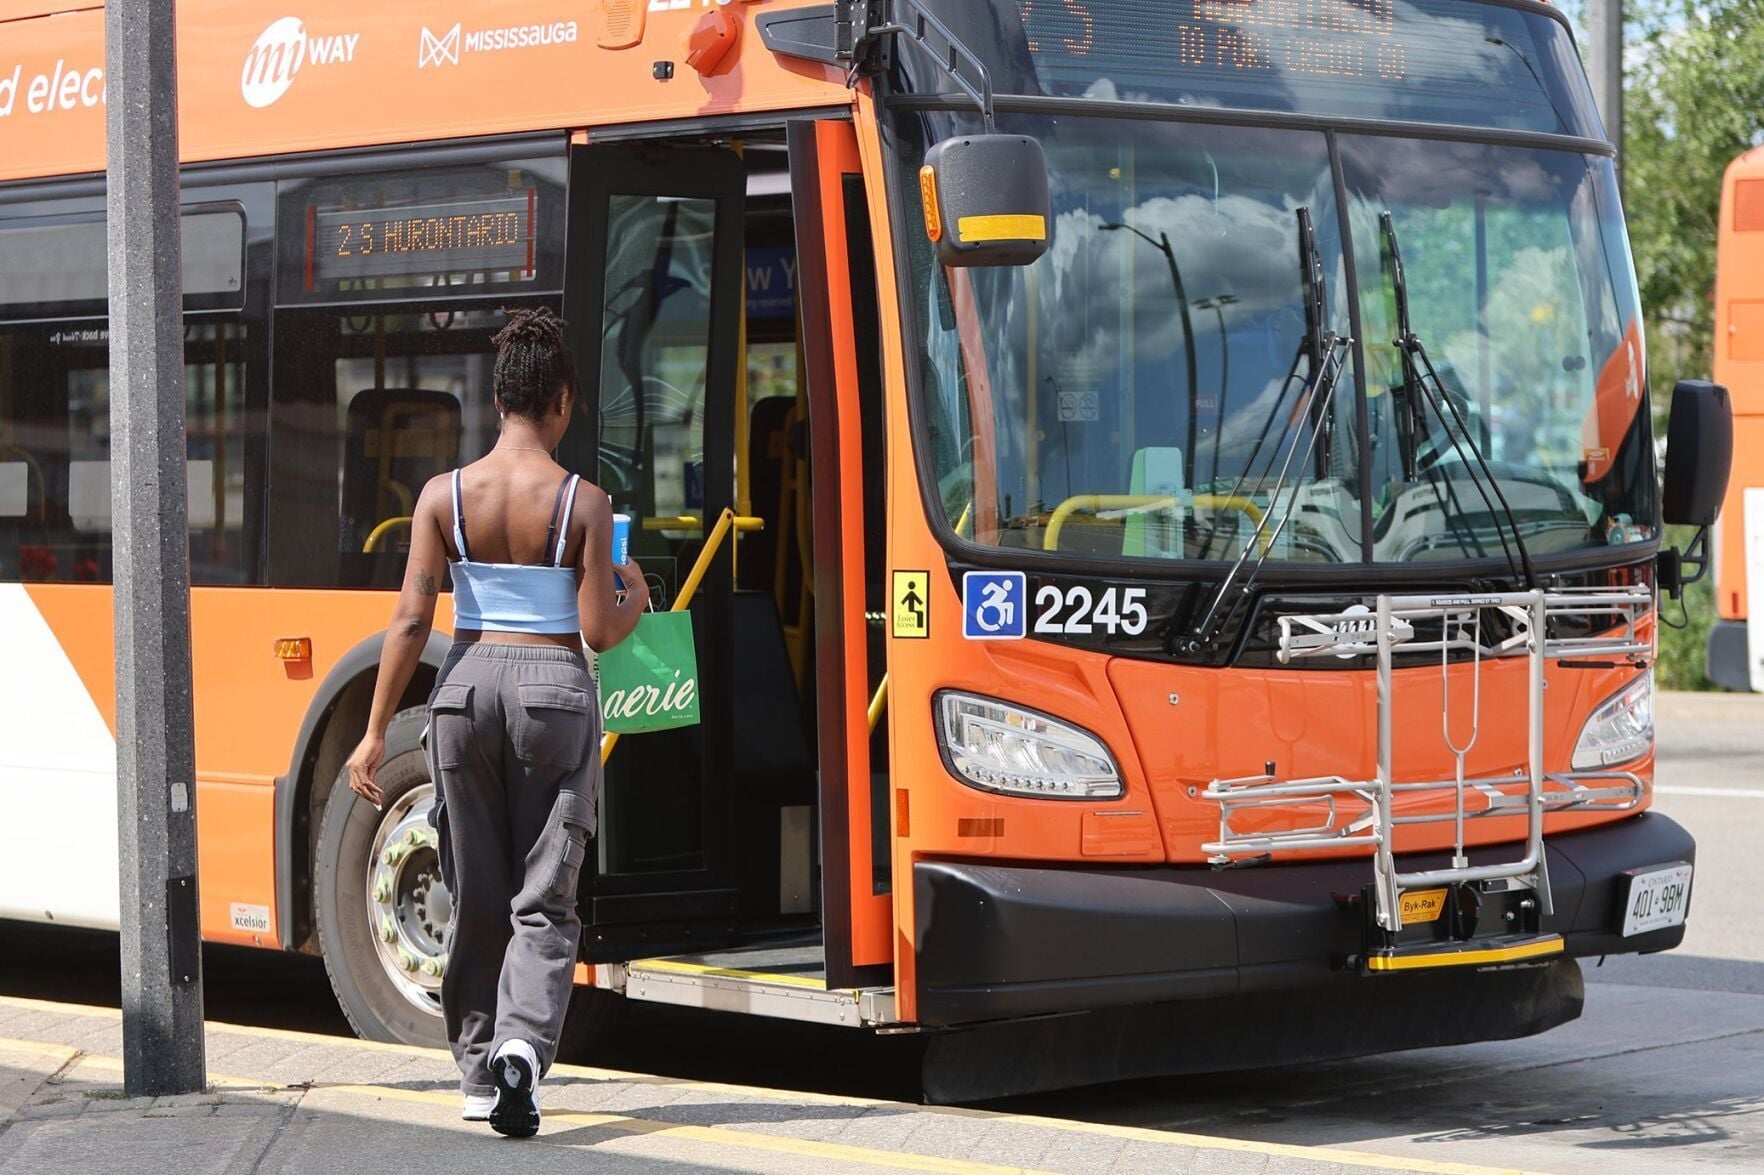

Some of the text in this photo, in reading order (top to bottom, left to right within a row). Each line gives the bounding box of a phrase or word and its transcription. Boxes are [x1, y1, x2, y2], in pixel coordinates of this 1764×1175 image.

[27, 58, 107, 114] elec
[338, 212, 519, 256] 2 S HURONTARIO
[1034, 585, 1148, 636] 2245
[603, 669, 695, 720] aerie
[234, 914, 267, 929] xcelsior
[1404, 898, 1436, 912] Byk-Rak
